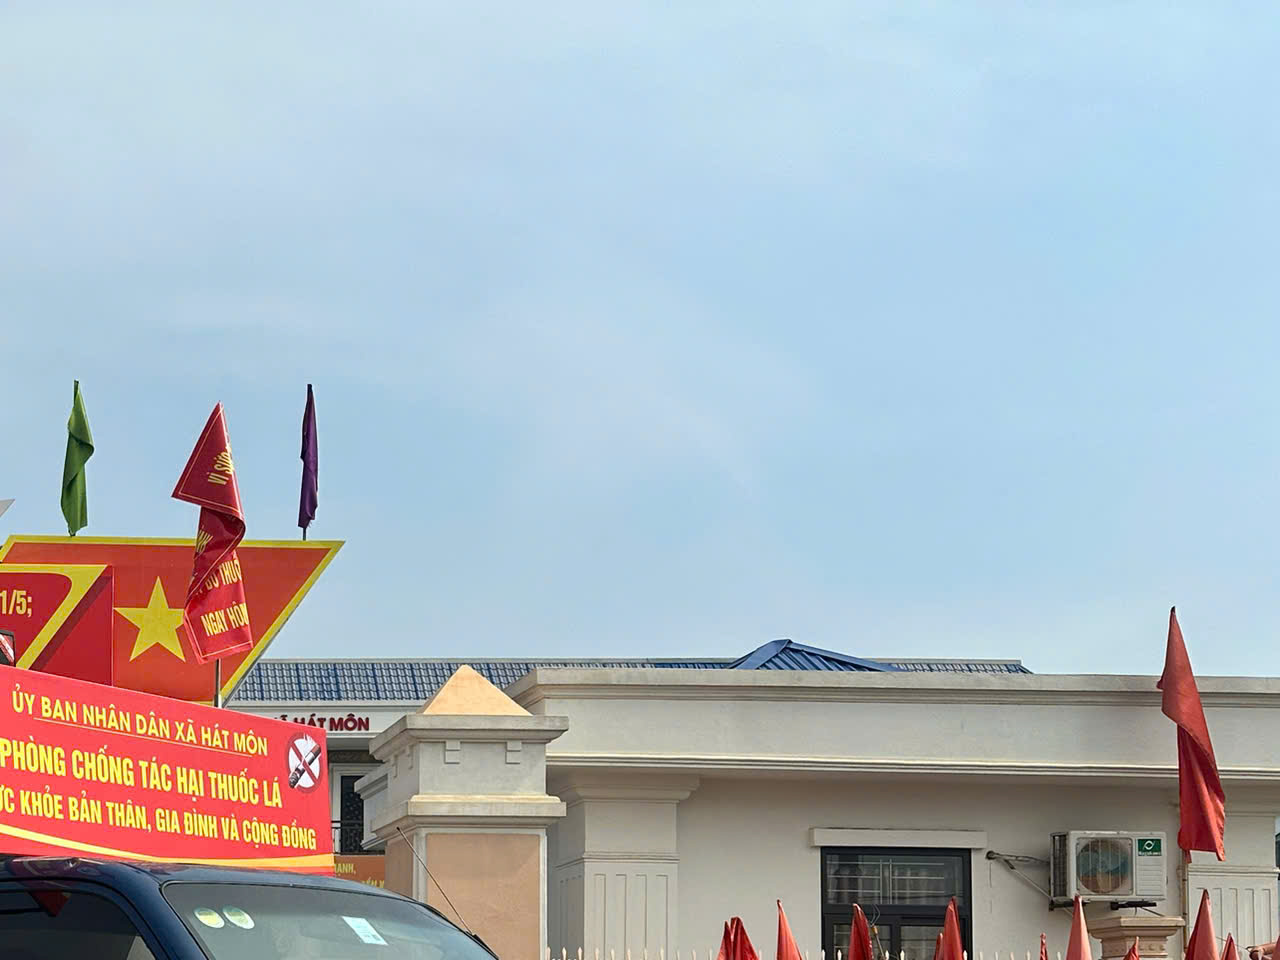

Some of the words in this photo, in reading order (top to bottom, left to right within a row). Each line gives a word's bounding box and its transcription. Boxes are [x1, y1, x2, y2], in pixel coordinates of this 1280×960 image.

[12, 683, 36, 715] ỦY
[41, 696, 77, 723] BAN
[82, 704, 132, 732] NHÂN
[136, 710, 170, 739] DÂN
[174, 718, 197, 744] XÃ
[201, 723, 230, 750] HÁT
[234, 730, 268, 756] MÔN
[329, 713, 370, 731] MÔN
[72, 744, 135, 787] CHỐNG
[138, 756, 172, 792] TÁC
[176, 766, 204, 802] HẠI
[208, 768, 260, 805] THUỐC
[262, 776, 282, 808] LÁ
[20, 784, 64, 820] KHỎE
[68, 790, 102, 825] BẢN
[106, 799, 152, 833] THÂN,
[155, 808, 181, 834] GIA
[184, 808, 218, 839] ĐÌNH
[220, 814, 240, 841] VÀ
[242, 816, 279, 848] CỘNG
